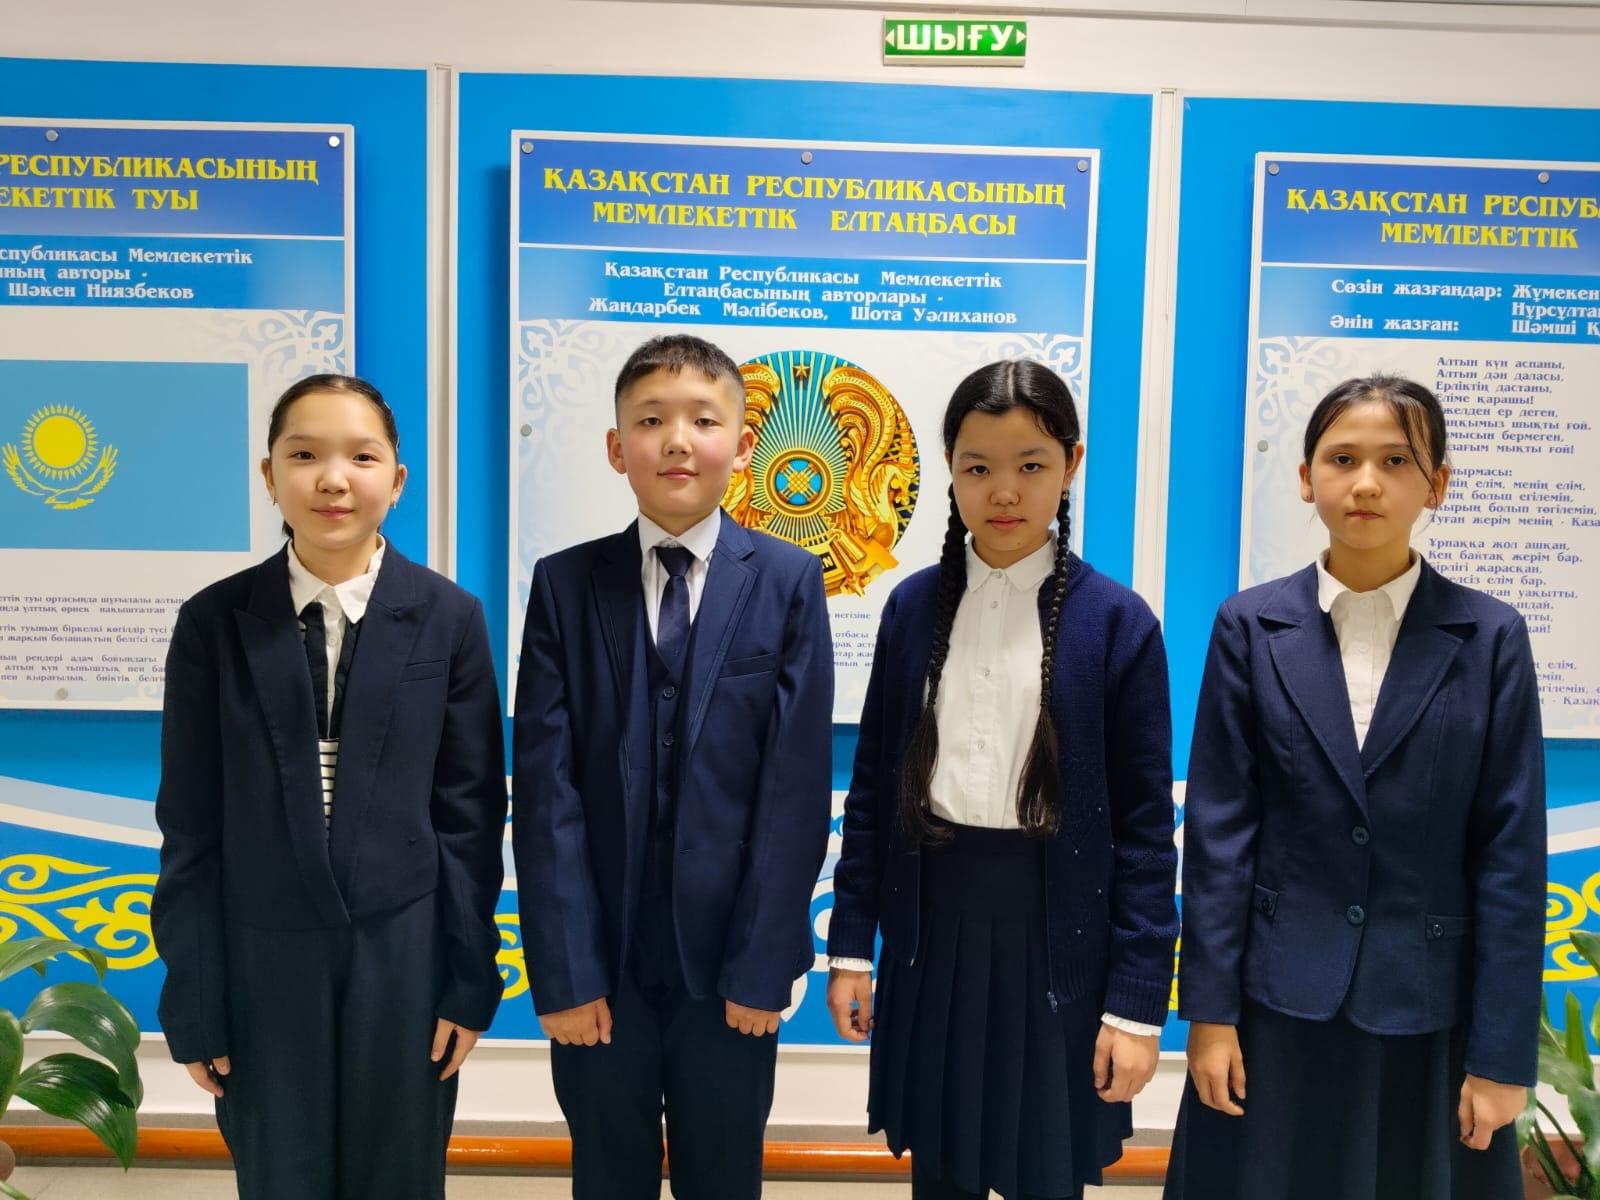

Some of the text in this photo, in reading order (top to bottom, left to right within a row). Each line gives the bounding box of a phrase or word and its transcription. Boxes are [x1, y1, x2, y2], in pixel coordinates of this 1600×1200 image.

[896, 24, 1014, 51] ШЫҒУ
[543, 166, 1066, 210] ҚАЗАҚСТАН РЕСПУБЛИКАСЫНЫҢ
[132, 189, 199, 210] ТУЫ
[1287, 188, 1600, 218] ҚАЗАҚСТАН РЕСПУБ
[593, 201, 1017, 237] МЕМЛЕКЕТТІК ЕЛТАҢБАСЫ
[1381, 222, 1578, 249] МЕМЛЕКЕТТІК
[129, 248, 253, 264] Мемлекеттік
[57, 268, 131, 284] авторы
[604, 261, 1002, 289] Қазақстан Республикасы Мемлекеттік
[8, 282, 194, 300] Шәкен Ниязбеков
[663, 282, 811, 304] Елтаңбасының
[821, 288, 927, 306] авторлары
[1331, 279, 1384, 295] Сөзін
[1393, 283, 1502, 302] жазғандар:
[588, 297, 1017, 325] Жандарбек Мәлібеков, Шота Уәлиханов
[1330, 314, 1373, 330] Әнін
[1384, 318, 1460, 333] жазған:
[1511, 319, 1577, 336] Шәмші
[1437, 357, 1478, 367] Алтын
[1485, 360, 1508, 370] күн
[1436, 369, 1478, 379] Алтын
[1484, 372, 1507, 381] дән
[1436, 381, 1489, 393] Ерліктің
[1477, 396, 1534, 406] қарашы!
[1442, 408, 1491, 417] желден
[1498, 410, 1513, 419] ер
[1512, 421, 1559, 430] шықты
[1549, 445, 1575, 454] ғой!
[1513, 480, 1549, 490] менің
[1472, 490, 1512, 501] болып
[1488, 503, 1529, 513] болып
[1472, 515, 1511, 527] жерім
[1518, 516, 1553, 527] менің
[1428, 538, 1485, 549] Ұрпаққа
[1492, 541, 1518, 549] жол
[1460, 550, 1504, 561] байтақ
[1512, 552, 1550, 563] жерім
[1557, 552, 1583, 564] бар.
[1487, 575, 1513, 585] елім
